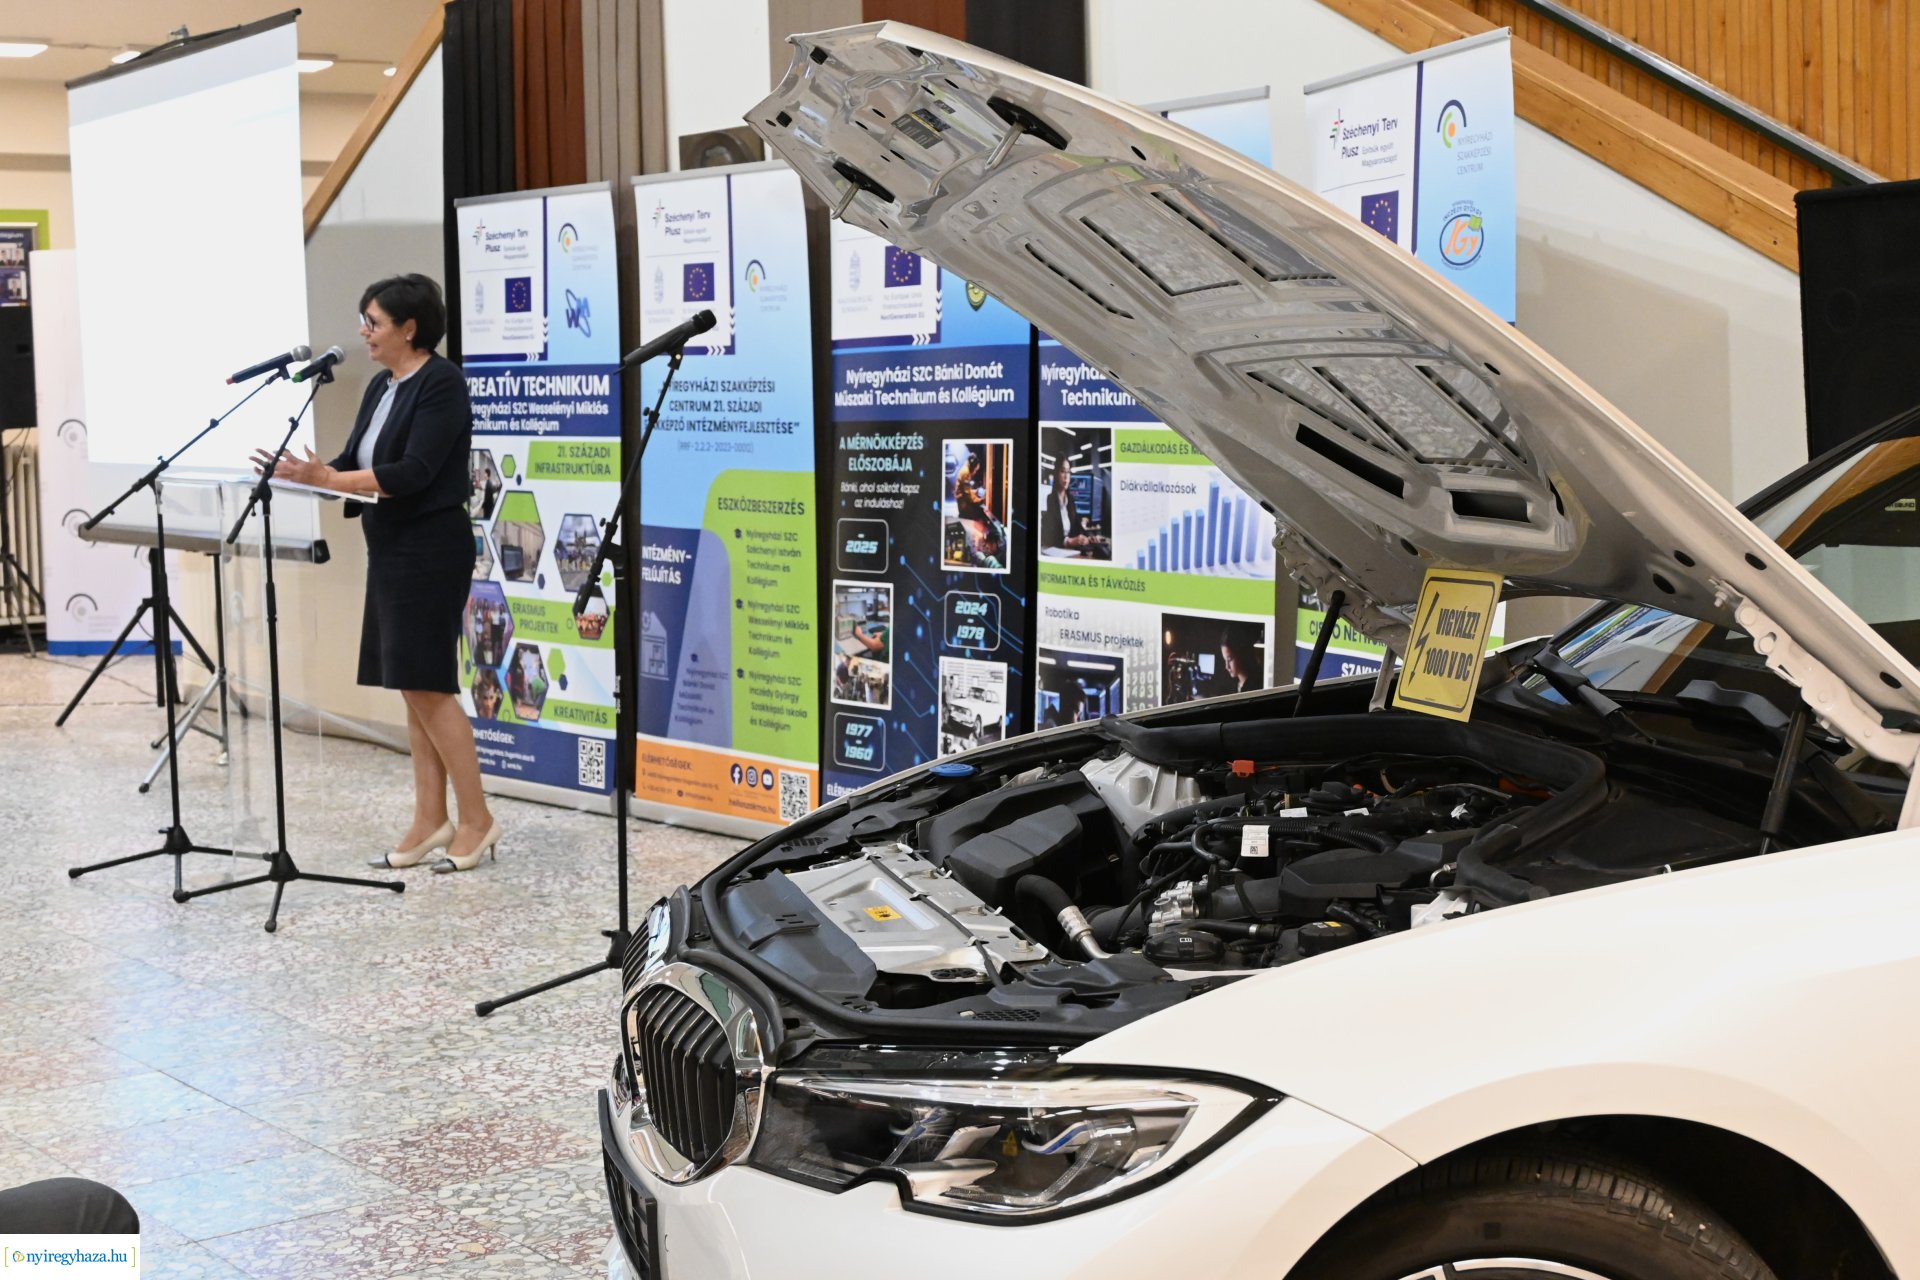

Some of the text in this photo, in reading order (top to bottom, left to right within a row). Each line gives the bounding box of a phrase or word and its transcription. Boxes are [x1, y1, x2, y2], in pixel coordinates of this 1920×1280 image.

[846, 361, 1003, 389] Nyíregyházi SZC Bánki Donát
[522, 374, 610, 397] TECHNIKUM
[720, 377, 776, 393] SZAKKÉPZÉSI
[835, 384, 1015, 407] Műszaki Technikum és Kollégium
[471, 400, 609, 418] íregyházi SZC Wesselényi Miklós
[669, 397, 763, 413] CENTRUM 21. SZÁZADI
[510, 417, 520, 431] és
[520, 418, 560, 434] Kollégium
[839, 432, 924, 451] A MÉRNÖKKÉPZÉS
[1120, 440, 1178, 455] GAZDÁLKODÁS
[1179, 441, 1189, 455] ÉS
[569, 443, 611, 458] SZÁZADI
[535, 462, 611, 476] INFRASTRUKTÚRA
[848, 454, 913, 471] ELŐSZOBÁJA
[1120, 479, 1197, 495] Diákvállalkozások
[717, 496, 806, 516] ESZKÖZBESZERZÉS
[845, 540, 879, 554] 2025
[1088, 574, 1099, 588] ÉS
[1101, 575, 1146, 592] TÁVKÖZLÉS
[512, 603, 546, 616] ERASMUS
[955, 600, 988, 617] 2024
[1045, 606, 1080, 620] Robotika
[519, 619, 559, 634] PROJEKTEK
[1436, 606, 1481, 640] VIGYÁZZ!
[957, 625, 985, 640] 1978
[1060, 628, 1145, 649] ERASMUS projektek
[1423, 648, 1474, 682] 1000 V DC
[553, 705, 608, 725] KREATIVITÁS
[846, 723, 873, 737] 1977
[845, 745, 874, 761] 1960
